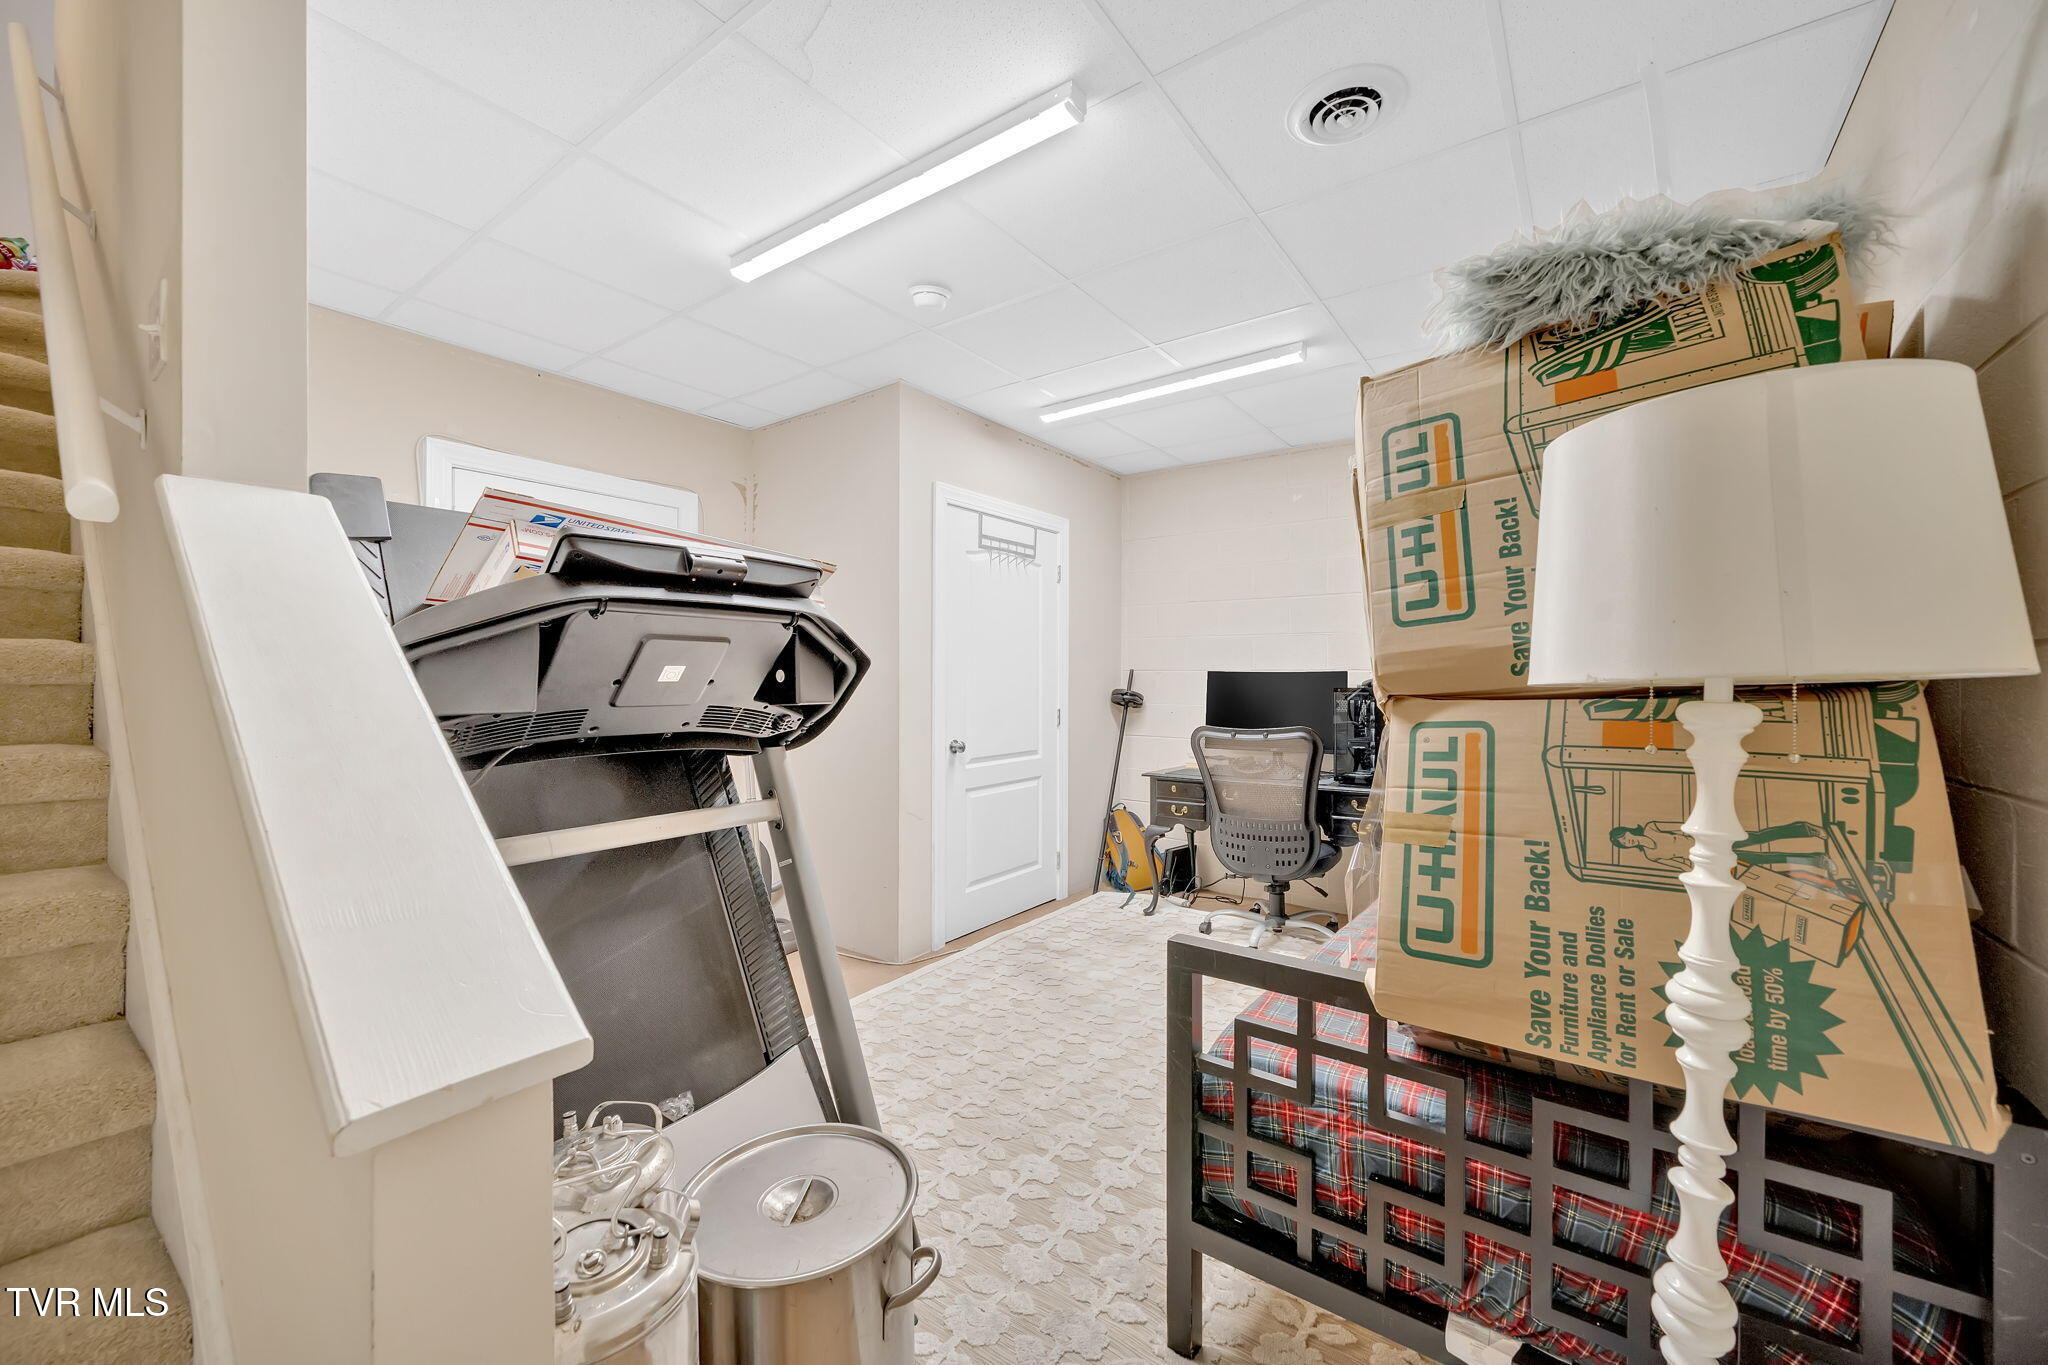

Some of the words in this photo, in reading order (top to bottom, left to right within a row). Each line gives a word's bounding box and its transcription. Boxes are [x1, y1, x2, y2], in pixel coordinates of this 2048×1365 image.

[567, 518, 605, 530] UNITED
[1396, 431, 1439, 611] U-HUL
[1494, 496, 1523, 559] Back!
[1504, 565, 1528, 616] Your
[1510, 621, 1531, 676] Save
[1524, 839, 1551, 913] Back!
[1524, 920, 1551, 978] Your
[1559, 931, 1578, 967] and
[1586, 905, 1606, 968] Dollies
[1614, 918, 1635, 960] Sale
[1618, 965, 1636, 987] or
[1762, 968, 1785, 1005] 50%
[1524, 989, 1552, 1049] Save
[1559, 973, 1579, 1056] Furniture
[1587, 974, 1612, 1063] Appliance
[1615, 992, 1637, 1038] Rent
[1765, 1008, 1790, 1030] by
[1615, 1043, 1637, 1069] for
[1767, 1034, 1788, 1071] time
